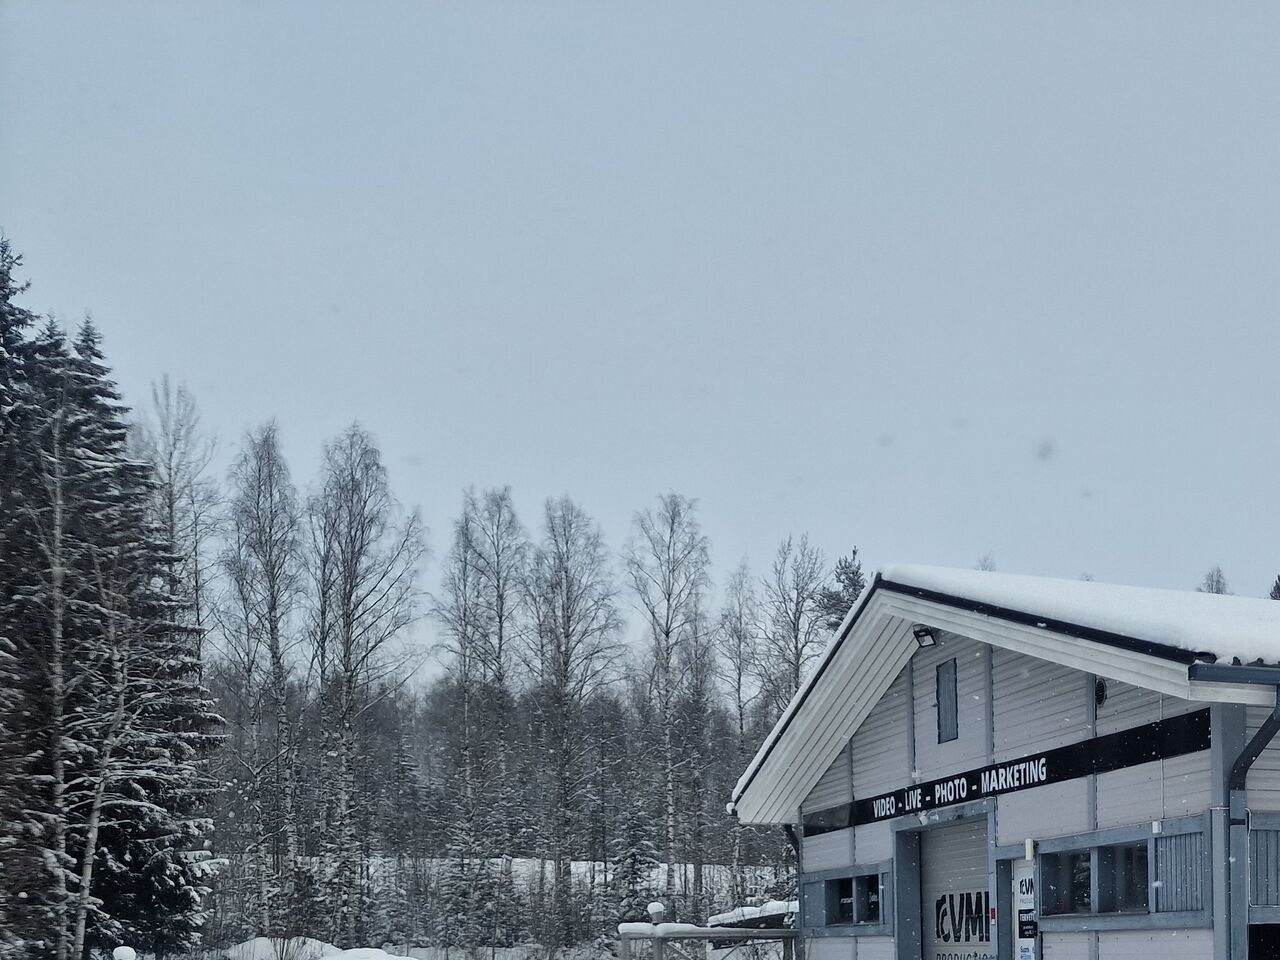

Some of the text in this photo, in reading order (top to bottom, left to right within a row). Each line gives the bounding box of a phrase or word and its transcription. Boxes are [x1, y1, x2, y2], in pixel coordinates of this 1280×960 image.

[873, 796, 896, 818] VIDEO
[904, 788, 922, 811] LIVE
[935, 777, 968, 804] PHOTO
[981, 757, 1047, 793] MARKETING
